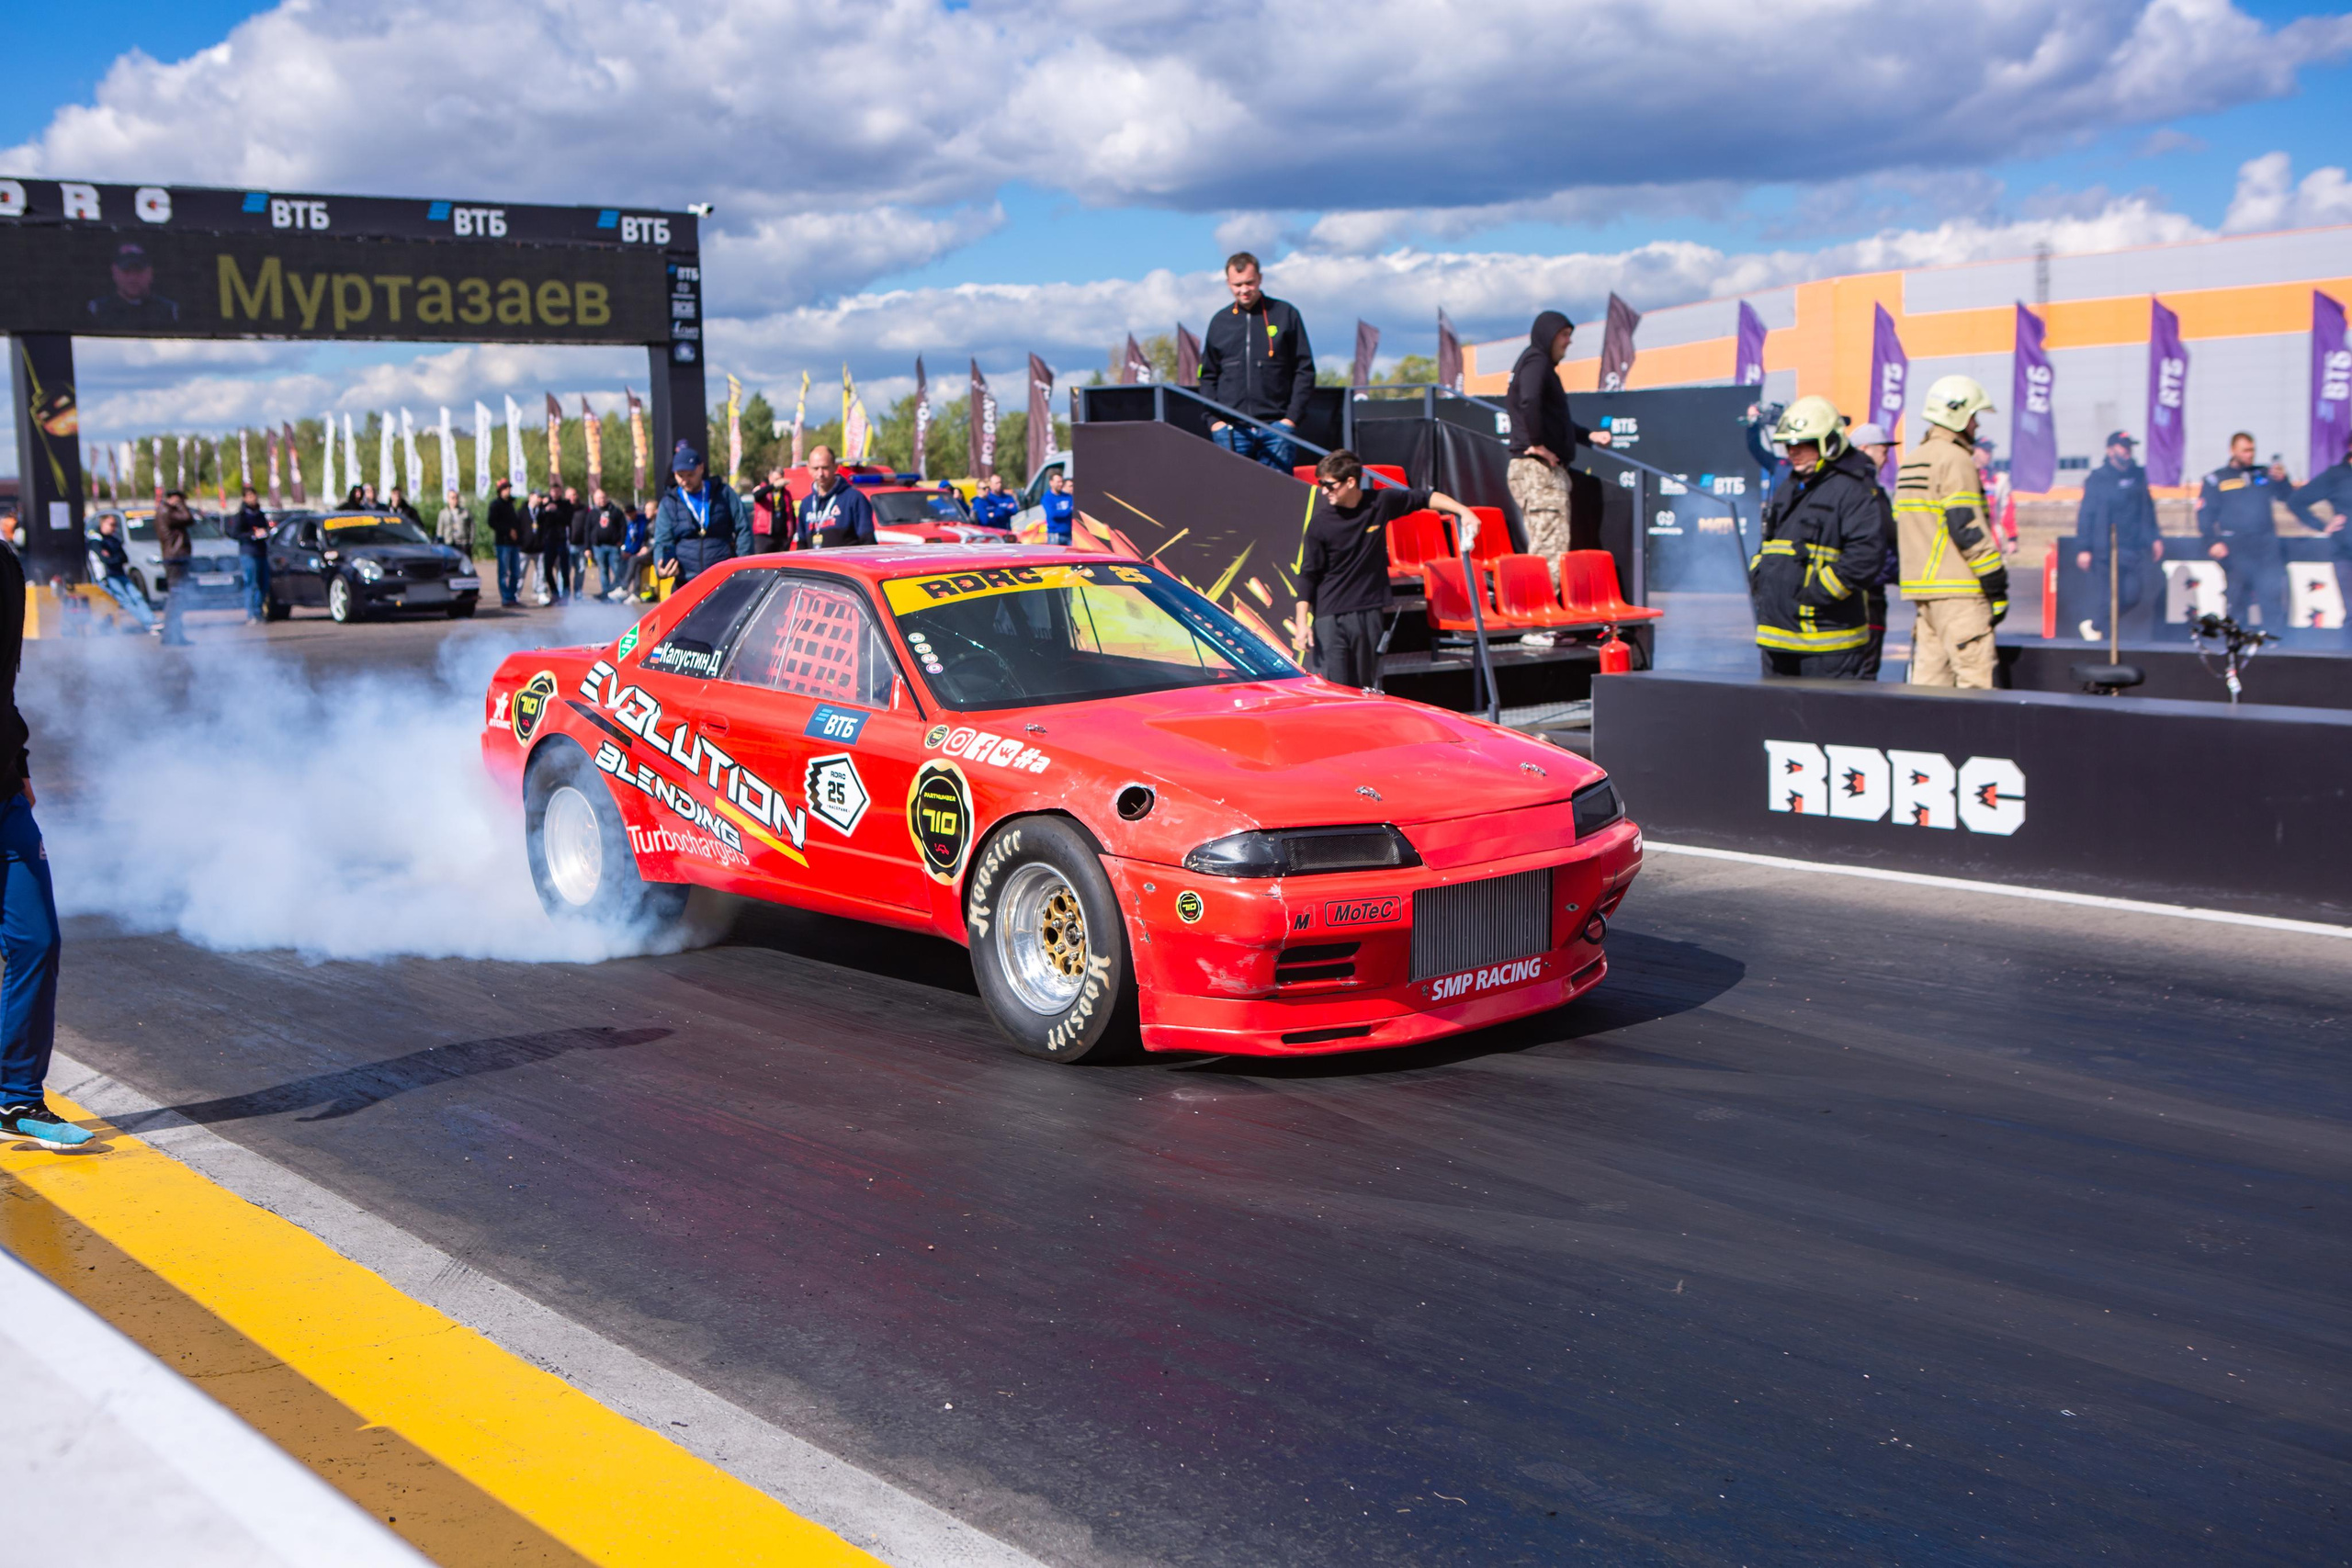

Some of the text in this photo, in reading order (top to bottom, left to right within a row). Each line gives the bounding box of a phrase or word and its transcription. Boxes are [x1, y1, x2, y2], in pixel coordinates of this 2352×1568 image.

[270, 198, 331, 231] ВТБ
[453, 207, 508, 238] ВТБ
[621, 216, 671, 244] ВТБ
[217, 254, 612, 332] Муртазаев
[1610, 417, 1638, 434] ВТБ
[1713, 476, 1746, 495] ВТБ
[916, 565, 1153, 600] RDRC 25
[659, 642, 707, 671] Капустин
[706, 649, 723, 677] Д
[823, 714, 859, 739] ВТБ
[579, 660, 807, 851] EVOLUTION
[594, 739, 744, 853] BLENDING
[827, 780, 845, 805] 25
[923, 791, 956, 803] PARTNUMBER
[1764, 739, 2027, 837] RDRC
[922, 808, 957, 836] 710
[627, 824, 751, 866] Turbochargers
[969, 829, 1022, 939] Hoosier
[1334, 900, 1395, 922] MoTeC
[1431, 957, 1542, 1001] SMP RACING
[1047, 950, 1112, 1051] Hoosier
